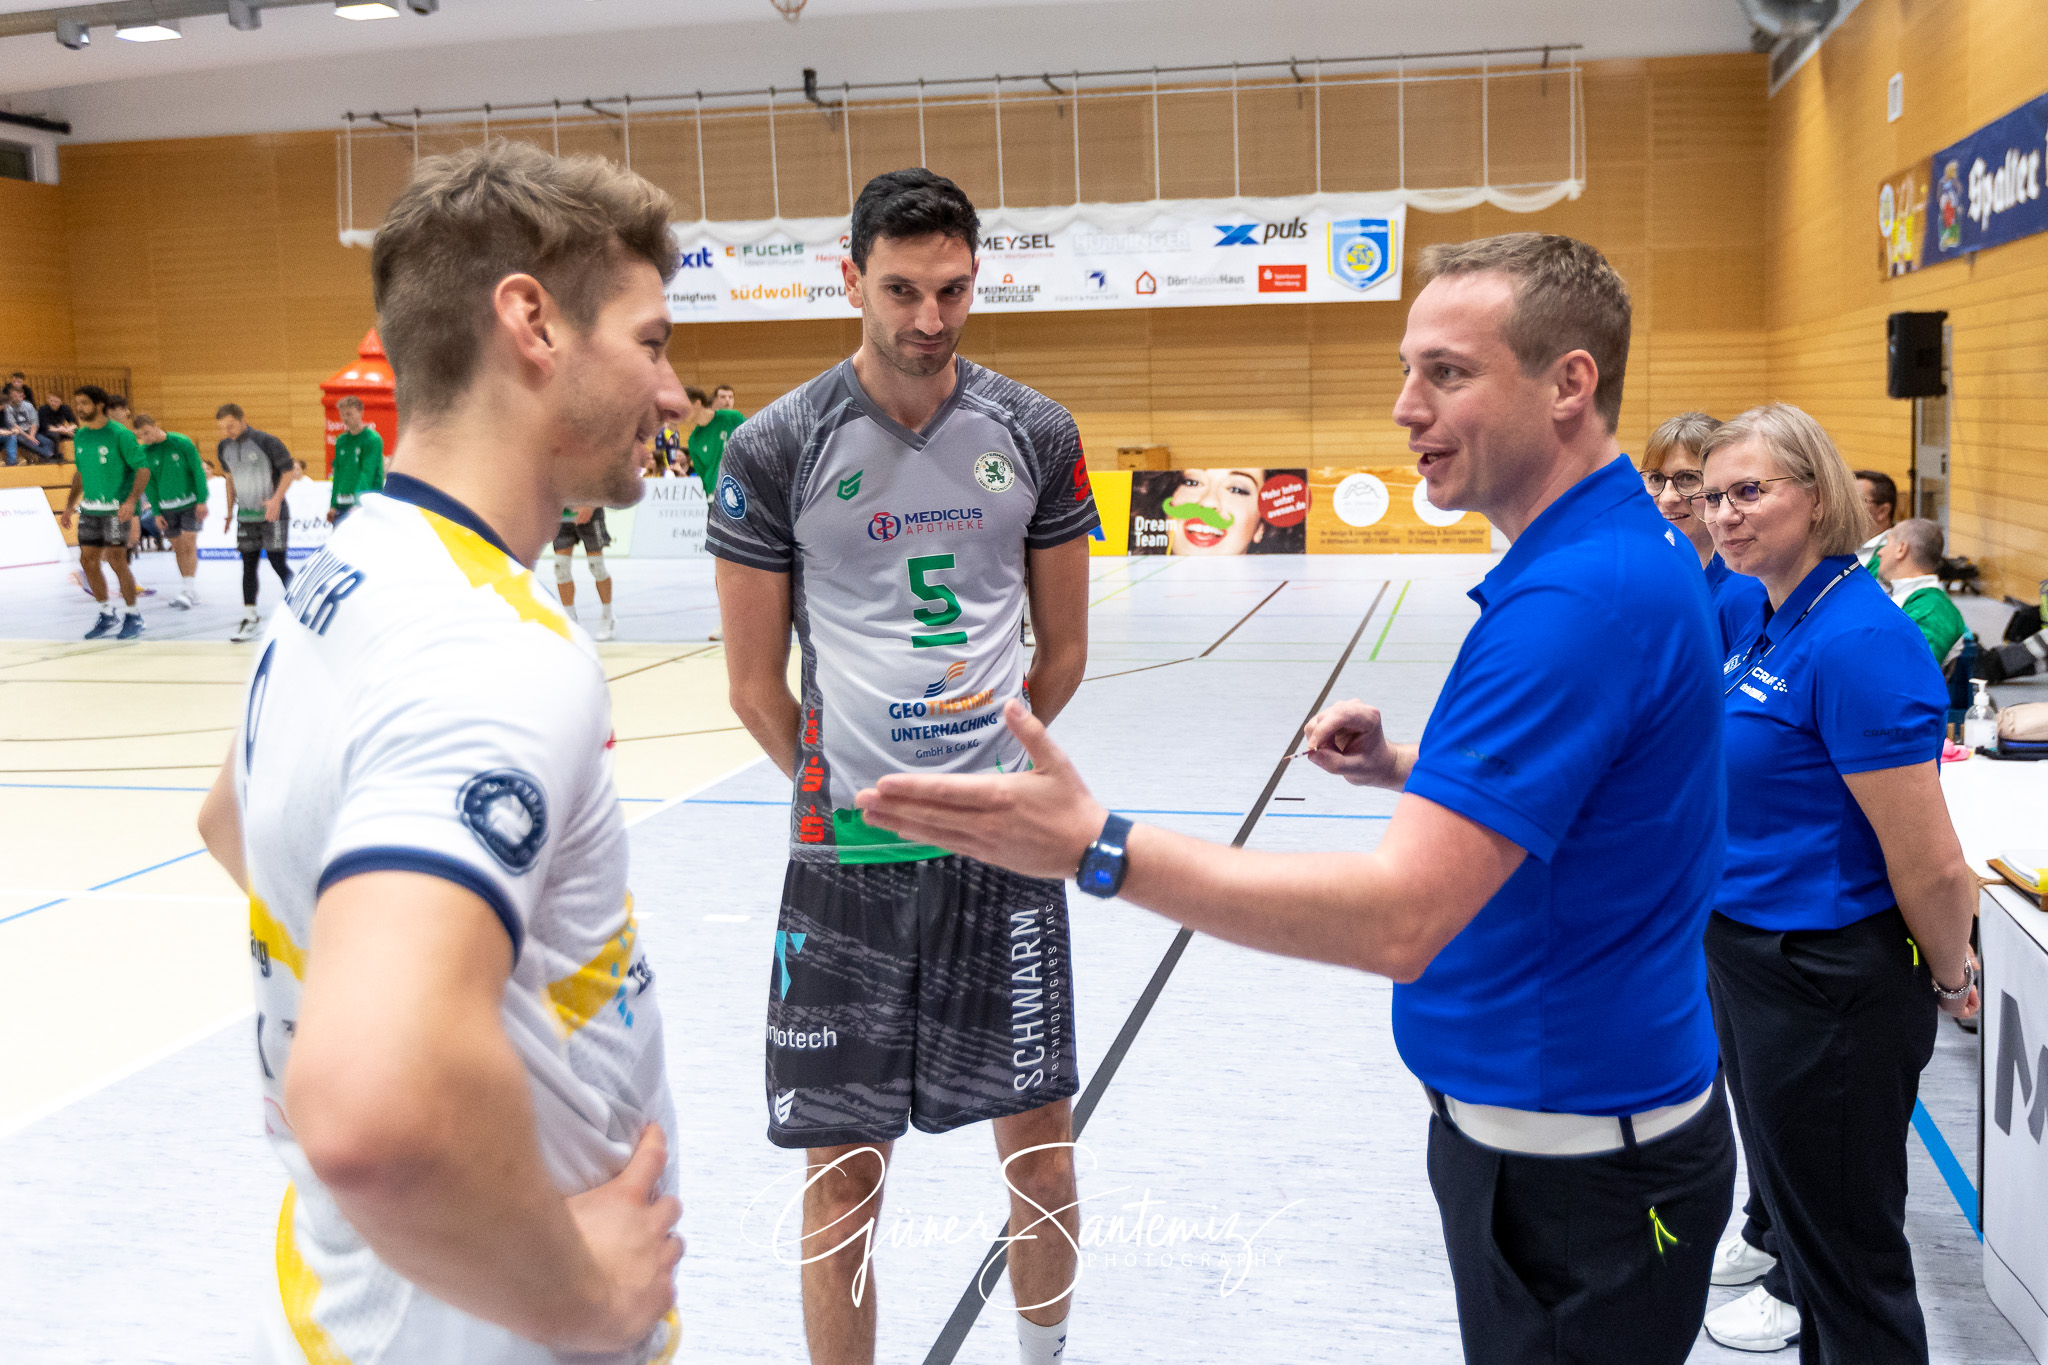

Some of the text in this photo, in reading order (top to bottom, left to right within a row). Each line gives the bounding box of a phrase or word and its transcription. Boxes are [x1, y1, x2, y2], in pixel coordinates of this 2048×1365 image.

[743, 242, 804, 256] FUCHS
[905, 507, 983, 525] MEDICUS
[1134, 515, 1178, 532] Dream
[906, 519, 984, 536] APOTHEKE
[1134, 532, 1168, 547] Team
[906, 553, 962, 627] 5
[888, 688, 995, 720] GEOTHERMIE
[890, 712, 999, 743] UNTERHACHING
[915, 738, 980, 759] GmbH & Co KG
[1010, 908, 1045, 1092] SCHWARM
